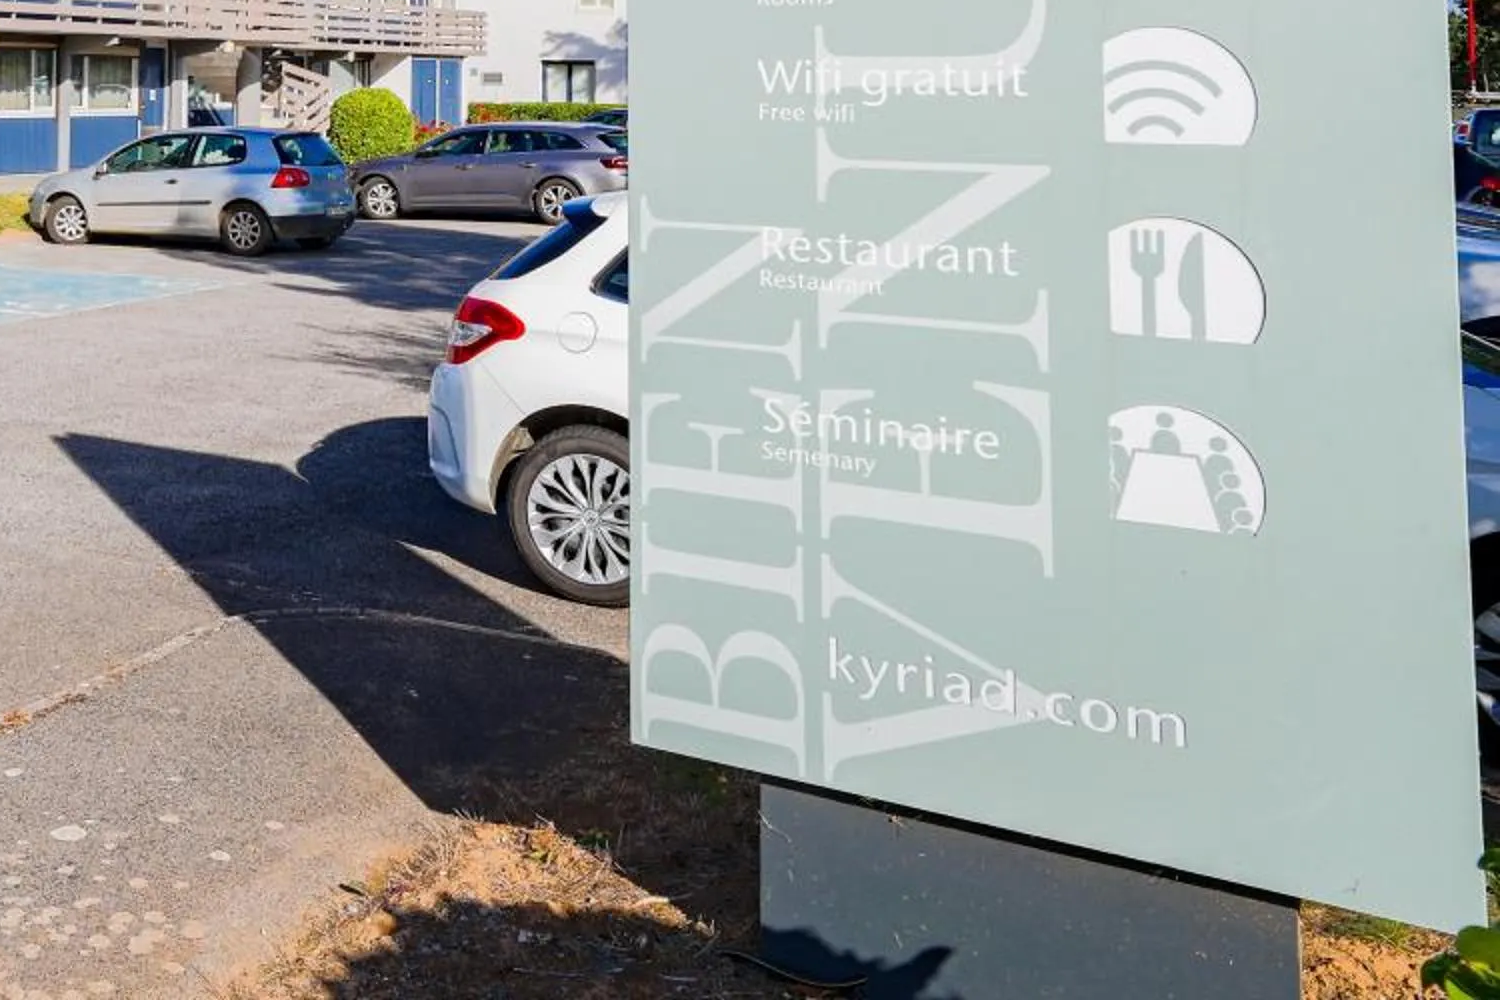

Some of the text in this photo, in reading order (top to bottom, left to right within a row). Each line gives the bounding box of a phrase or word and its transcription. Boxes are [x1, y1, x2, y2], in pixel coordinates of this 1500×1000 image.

[757, 57, 1030, 107] Wifi gratuit
[758, 103, 856, 124] Free wifi
[760, 226, 1021, 277] Restaurant
[759, 267, 885, 296] Restaurant
[763, 396, 1002, 460] Séminaire
[760, 439, 878, 478] Semenary
[828, 636, 1190, 749] kyriad.com
